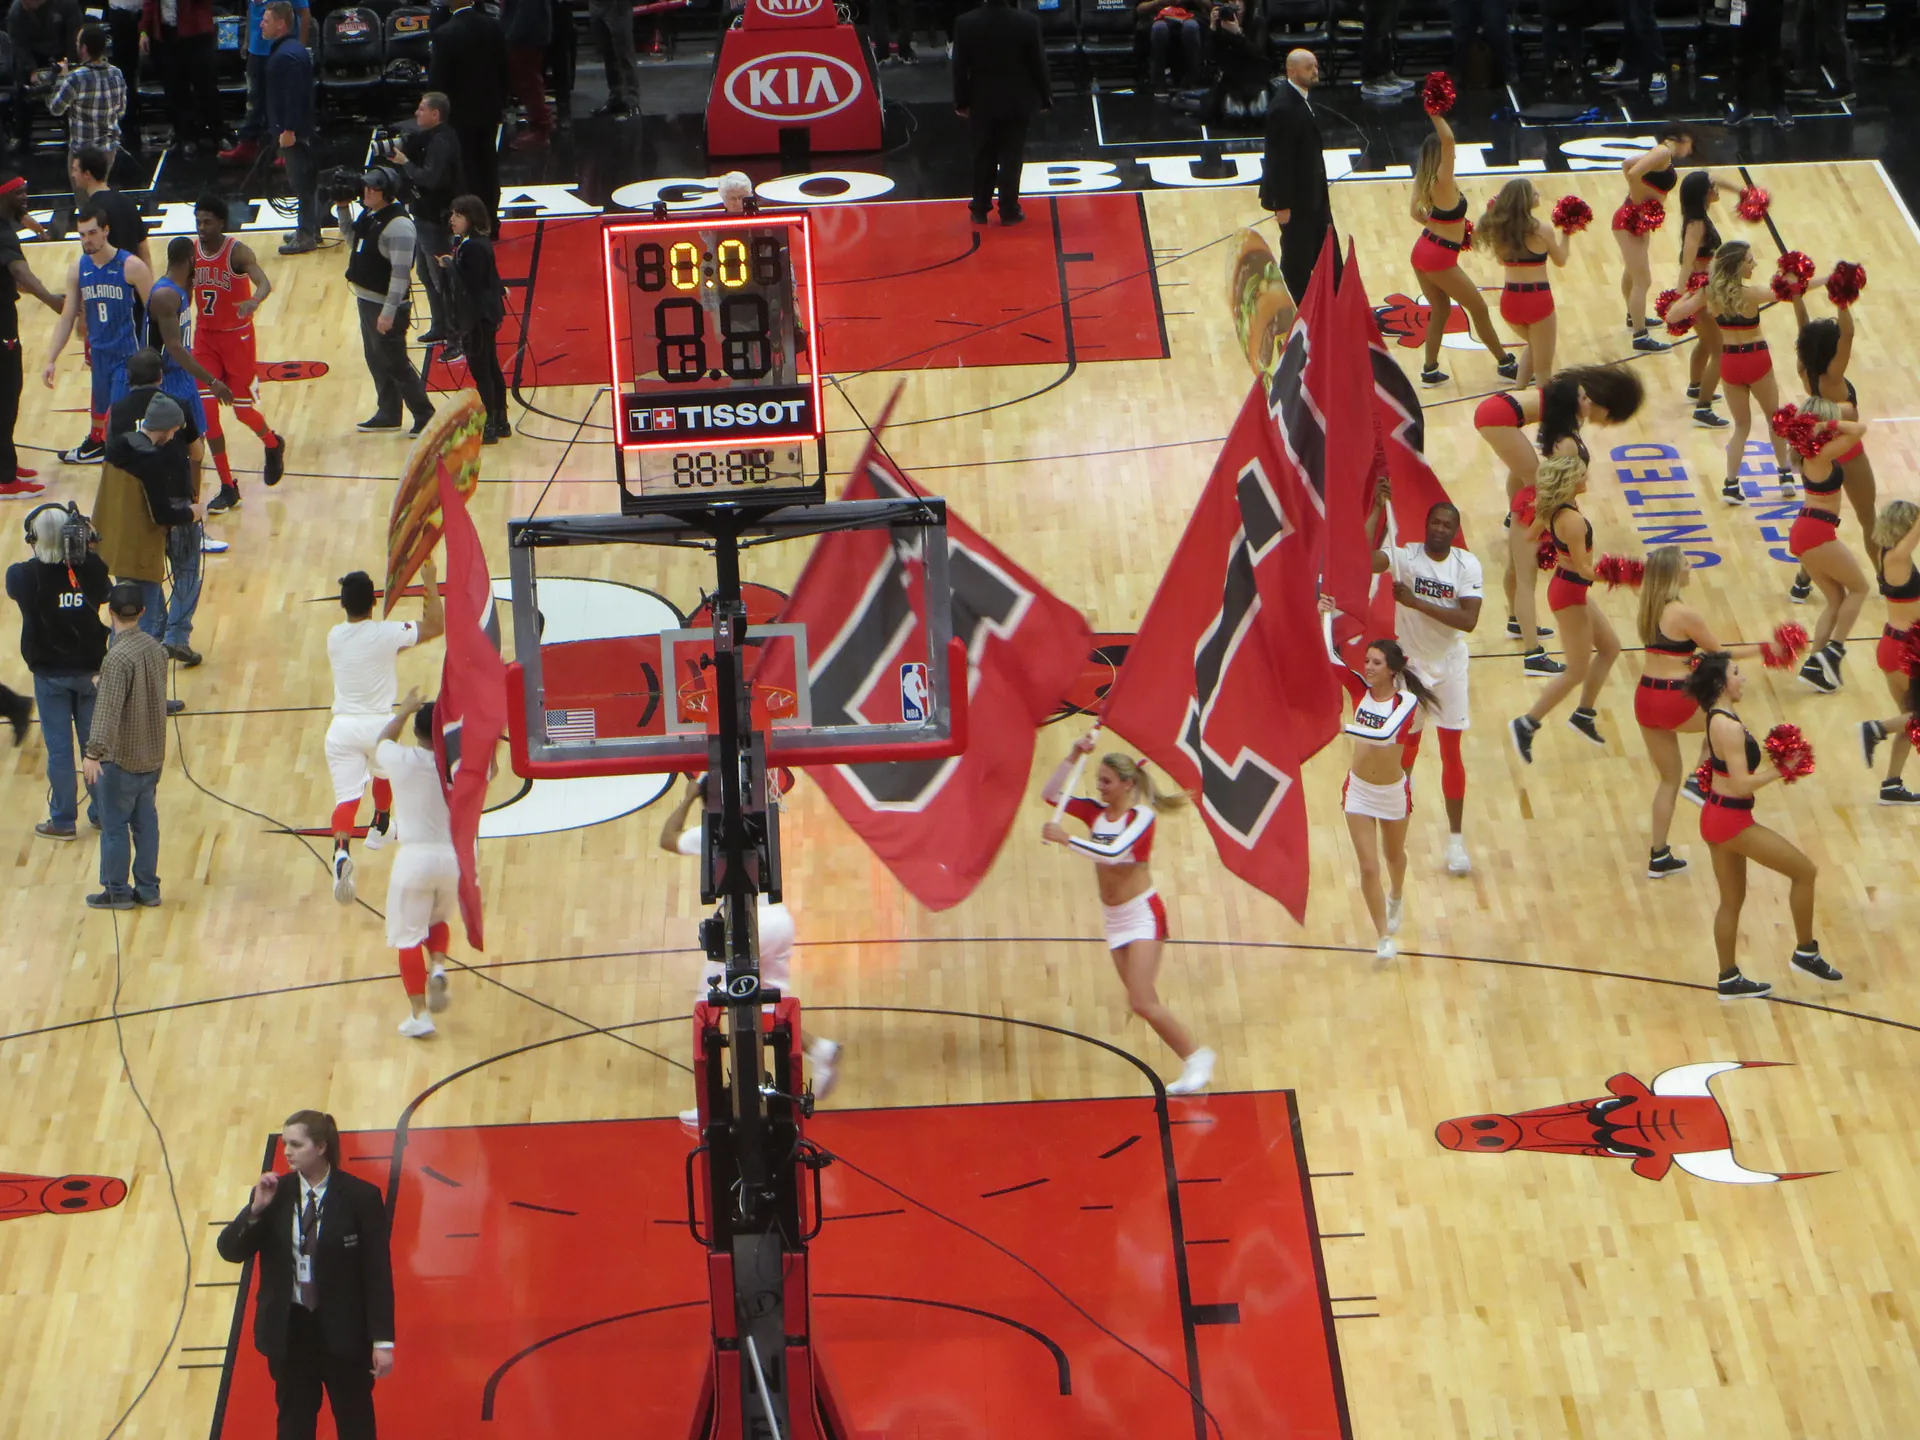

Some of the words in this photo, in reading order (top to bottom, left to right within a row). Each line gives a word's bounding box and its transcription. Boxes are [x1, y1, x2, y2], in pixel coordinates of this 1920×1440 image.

[747, 67, 840, 106] KIA
[193, 266, 232, 291] ULLS
[97, 302, 108, 323] 8
[202, 290, 217, 315] 7
[678, 400, 806, 429] TISSOT
[1609, 443, 1722, 569] UNITED
[58, 592, 84, 608] 106
[906, 708, 920, 719] NBA
[1357, 708, 1388, 723] INCRED
